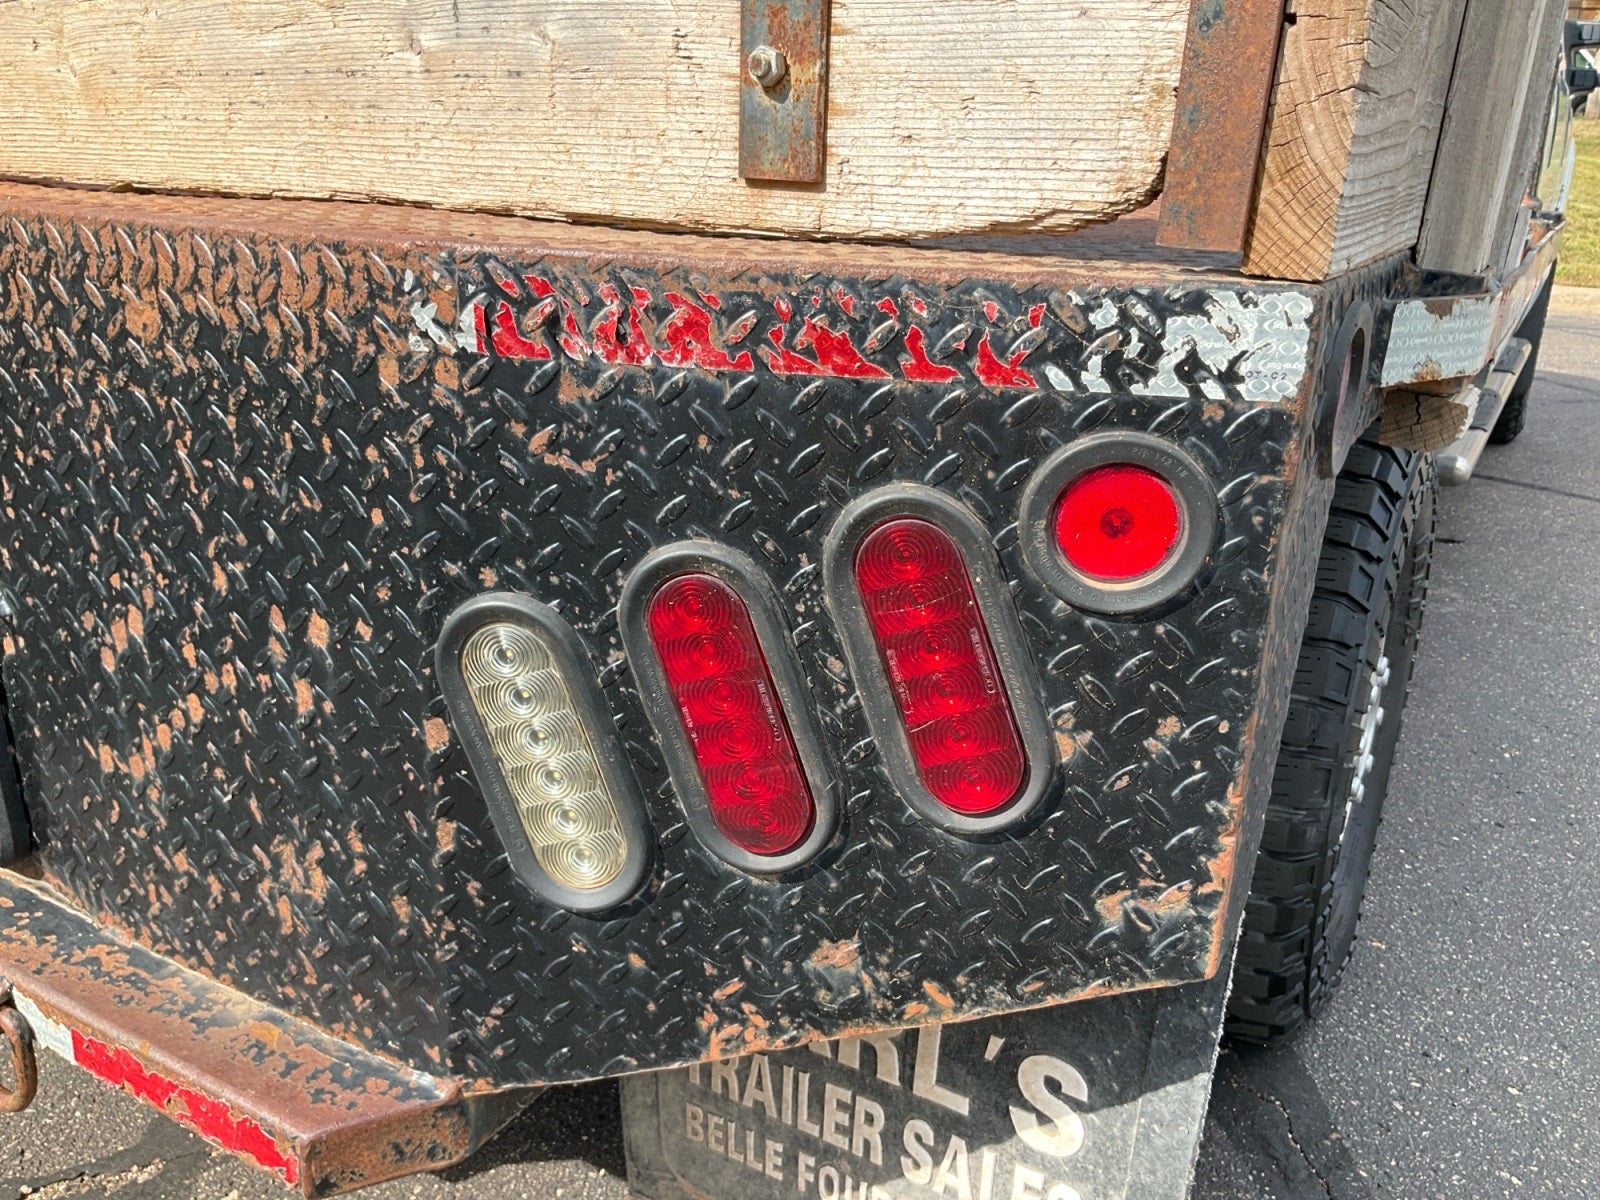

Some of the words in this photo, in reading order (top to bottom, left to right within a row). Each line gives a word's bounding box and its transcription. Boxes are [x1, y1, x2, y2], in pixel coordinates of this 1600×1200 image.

[1244, 369, 1288, 380] OT-C2
[685, 1102, 785, 1181] BELLE
[900, 1118, 1082, 1200] SALE
